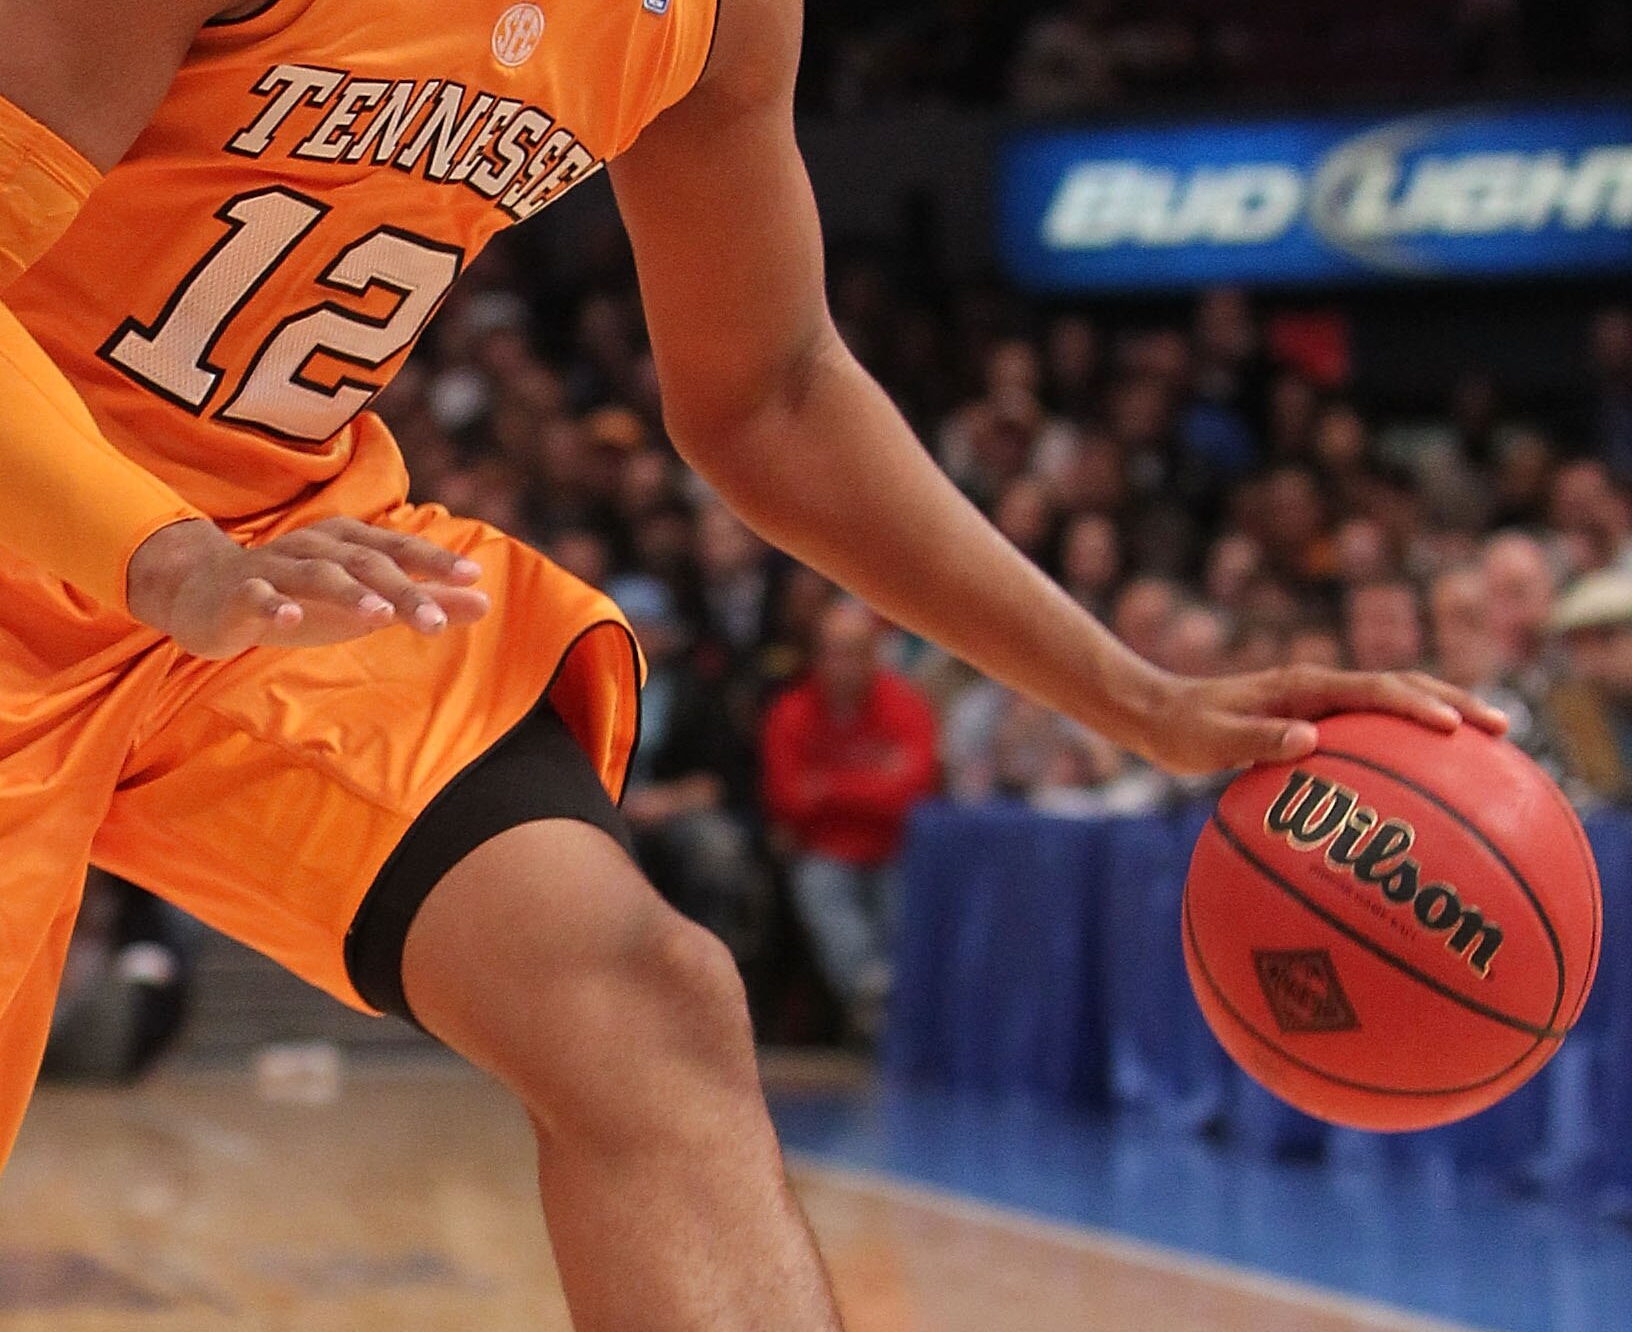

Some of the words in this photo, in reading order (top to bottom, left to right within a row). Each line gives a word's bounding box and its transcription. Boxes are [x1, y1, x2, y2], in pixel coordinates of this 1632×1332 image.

[224, 63, 606, 224] TENNESSE
[1042, 160, 1303, 250] BUD
[95, 184, 465, 445] 12
[1264, 769, 1504, 979] Wilson
